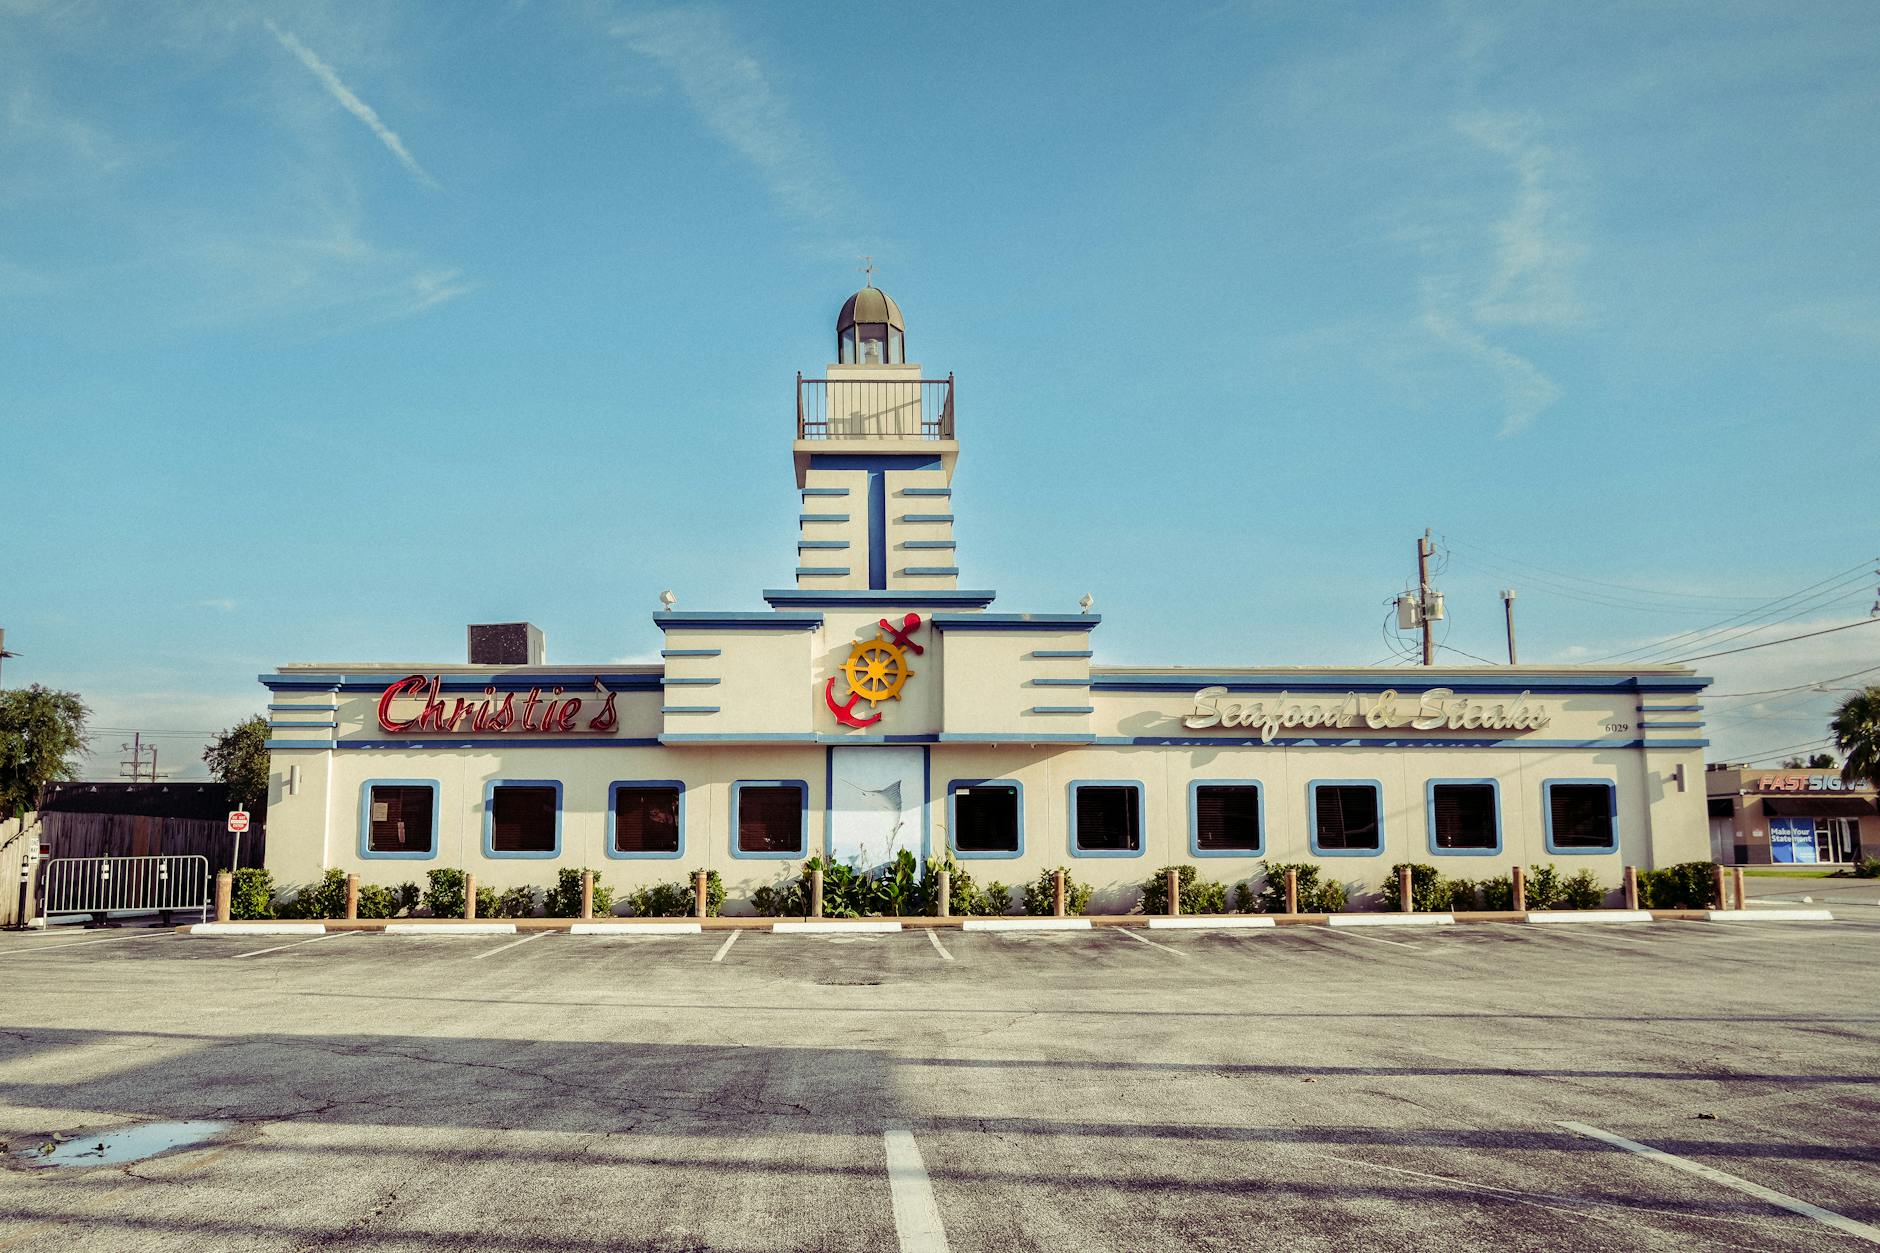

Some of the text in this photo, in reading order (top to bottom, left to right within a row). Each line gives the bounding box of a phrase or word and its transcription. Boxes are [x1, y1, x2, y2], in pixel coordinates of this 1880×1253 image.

[378, 675, 617, 732] Christie's
[1184, 686, 1551, 744] Seafood & Steaks
[1605, 723, 1629, 733] 6029
[1770, 828, 1810, 836] Make Your
